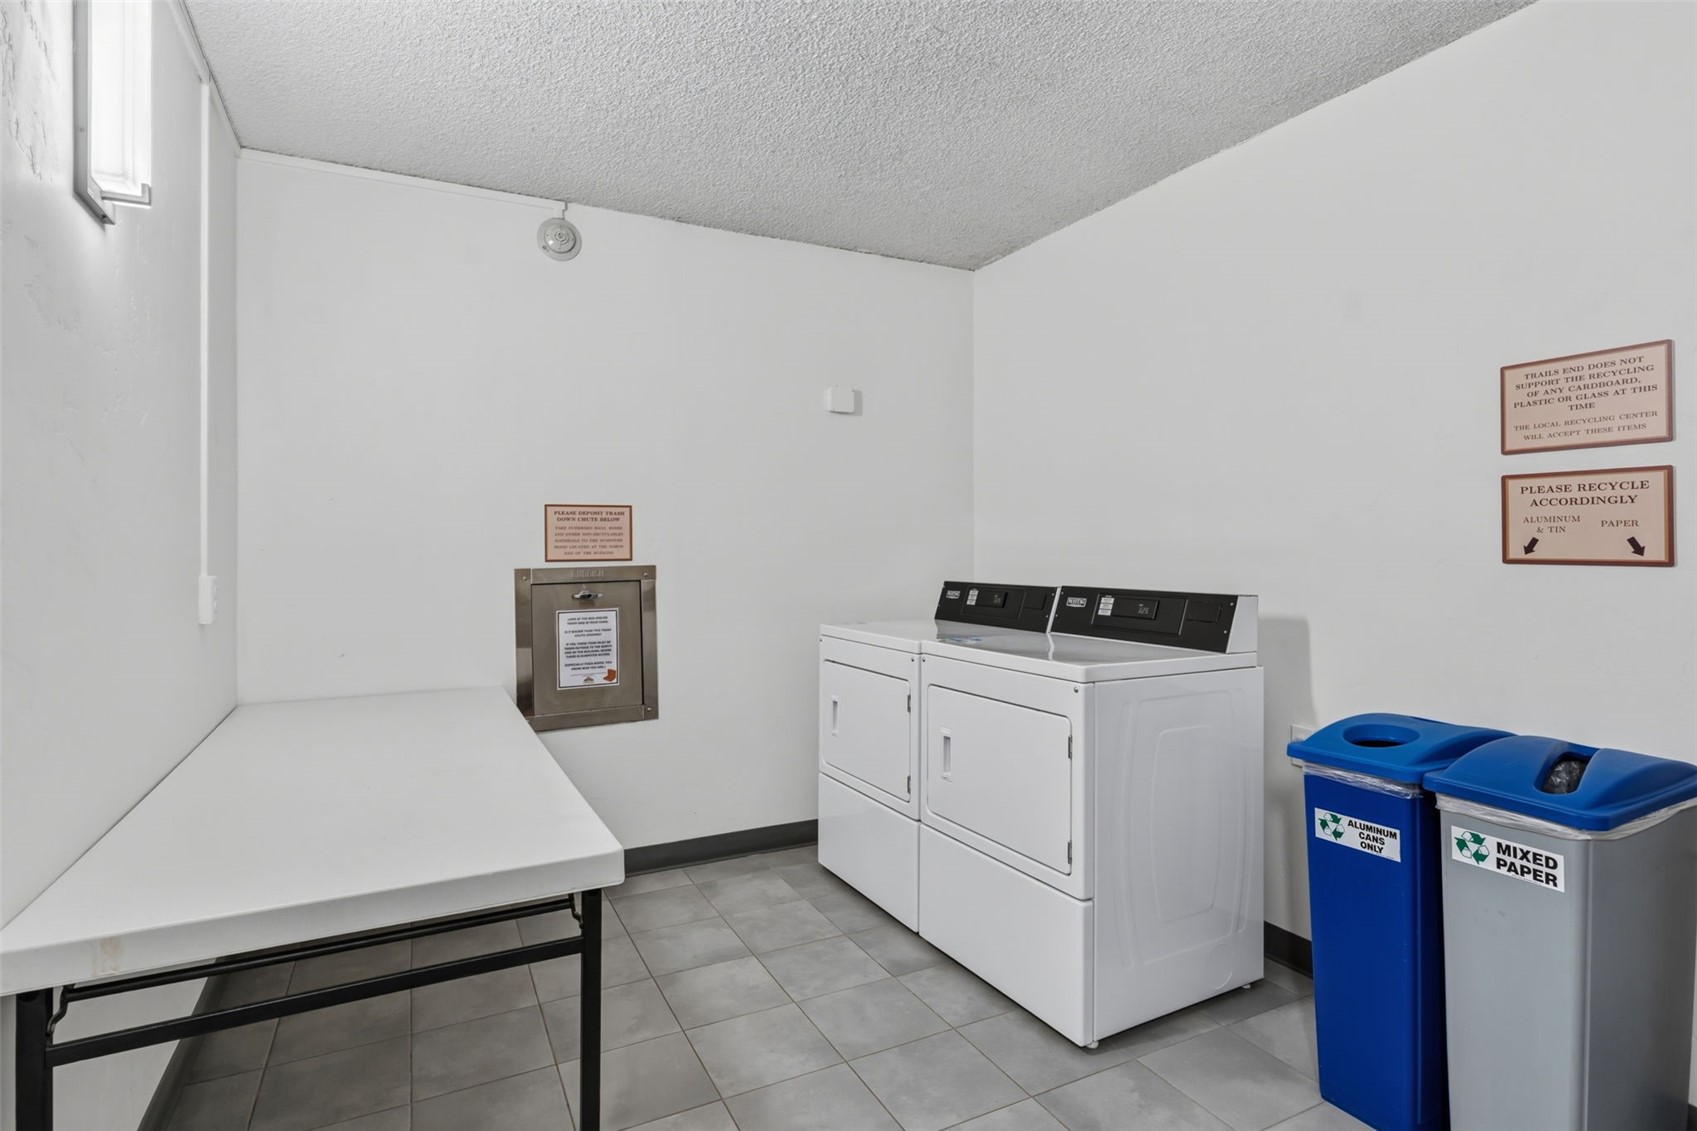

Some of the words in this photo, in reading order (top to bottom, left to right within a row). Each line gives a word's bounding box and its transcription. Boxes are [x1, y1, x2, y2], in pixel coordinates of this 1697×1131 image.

[1524, 369, 1559, 380] TRAILS
[1563, 366, 1585, 376] END
[1588, 362, 1617, 373] DOES
[1620, 356, 1644, 367] NOT
[1515, 378, 1562, 390] SUPPORT
[1564, 375, 1586, 384] THE
[1589, 365, 1655, 379] RECYCLING
[1514, 398, 1555, 408] PLASTIC
[1576, 391, 1609, 401] GLASS
[1613, 388, 1627, 396] AT
[1631, 384, 1658, 394] THIS
[1543, 387, 1568, 396] ANY
[1568, 402, 1596, 411] TIME
[1534, 420, 1561, 430] LOCAL
[1564, 415, 1615, 426] RECYCLING
[1619, 411, 1658, 420] CENTER
[1547, 430, 1581, 438] ACCEPT
[1584, 426, 1614, 434] THESE
[1618, 423, 1647, 432] ITEMS
[1521, 485, 1572, 494] PLEASE
[1578, 480, 1650, 491] RECYCLE
[1530, 495, 1638, 506] ACCORDINGLY
[1523, 515, 1580, 523] ALUMINUM
[1347, 820, 1397, 839] ALUMINUM
[1358, 832, 1385, 845] CANS
[1360, 842, 1384, 853] ONLY
[1496, 842, 1558, 870] MIXED
[1496, 857, 1558, 888] PAPER
